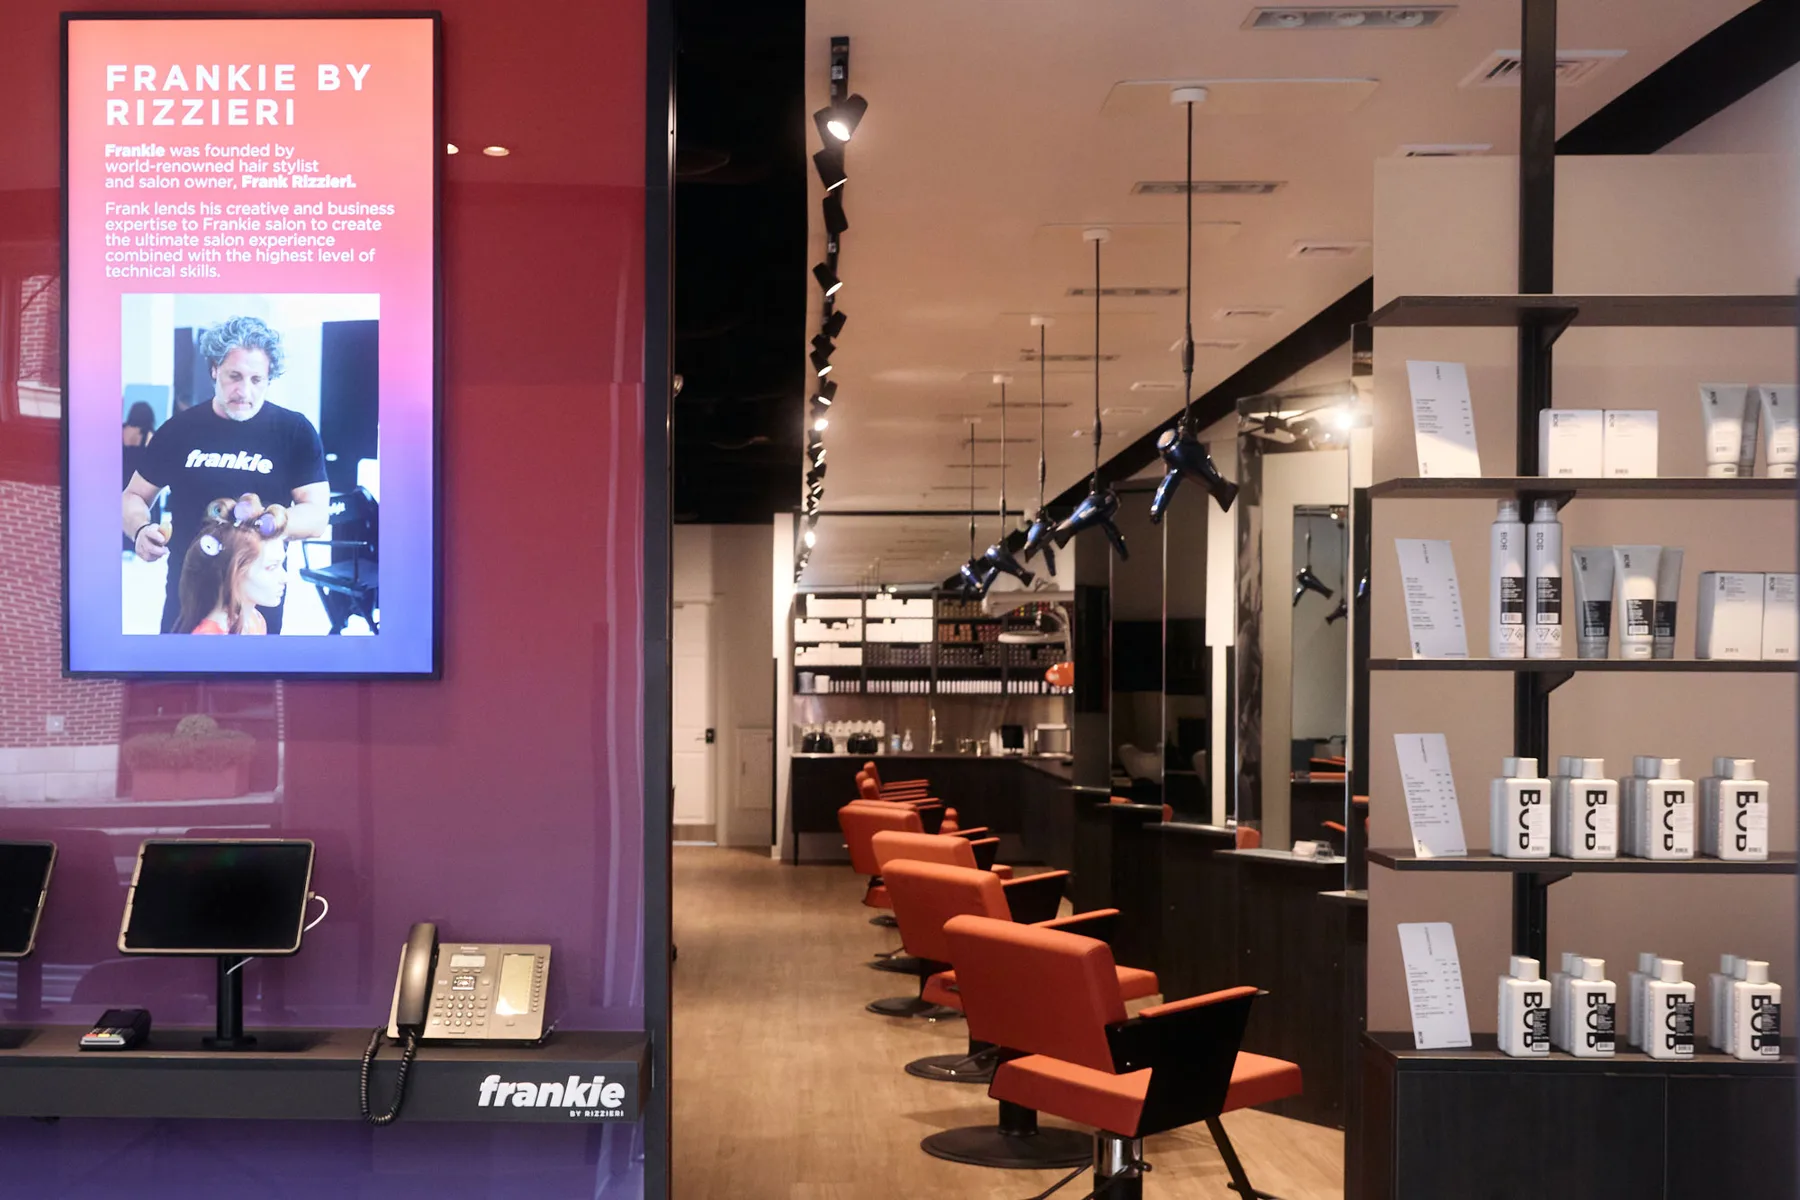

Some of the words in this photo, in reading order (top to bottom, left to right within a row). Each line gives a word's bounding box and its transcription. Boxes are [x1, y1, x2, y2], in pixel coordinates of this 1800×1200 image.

[107, 65, 296, 91] FRANKIE
[318, 64, 370, 90] BY
[107, 99, 294, 126] RIZZIERI
[105, 143, 165, 158] Frankie
[170, 147, 200, 157] was
[205, 144, 270, 158] founded
[275, 144, 295, 160] by
[105, 160, 234, 173] world-renowned
[239, 160, 268, 173] hair
[273, 159, 319, 174] stylist
[105, 175, 134, 188] and
[139, 175, 179, 188] salon
[184, 178, 237, 190] owner,
[242, 174, 291, 188] Frank
[292, 174, 356, 188] Rizzieri.
[106, 202, 149, 215] Frank
[155, 202, 195, 215] lends
[200, 202, 221, 215] his
[226, 202, 289, 215] creative
[294, 202, 322, 215] and
[328, 202, 394, 215] business
[105, 217, 177, 233] expertise
[182, 218, 198, 230] to
[204, 217, 260, 230] Frankie
[266, 217, 306, 230] salon
[311, 218, 327, 230] to
[332, 218, 382, 230] create
[105, 234, 131, 247] the
[135, 234, 199, 247] ultimate
[204, 234, 244, 247] salon
[249, 234, 335, 250] experience
[105, 249, 183, 262] combined
[188, 249, 221, 262] with
[226, 249, 251, 262] the
[256, 249, 313, 264] highest
[319, 249, 354, 262] level
[359, 248, 375, 262] of
[106, 264, 175, 277] technical
[180, 264, 220, 277] skills.
[185, 449, 273, 474] frankie
[478, 1074, 625, 1108] frankie
